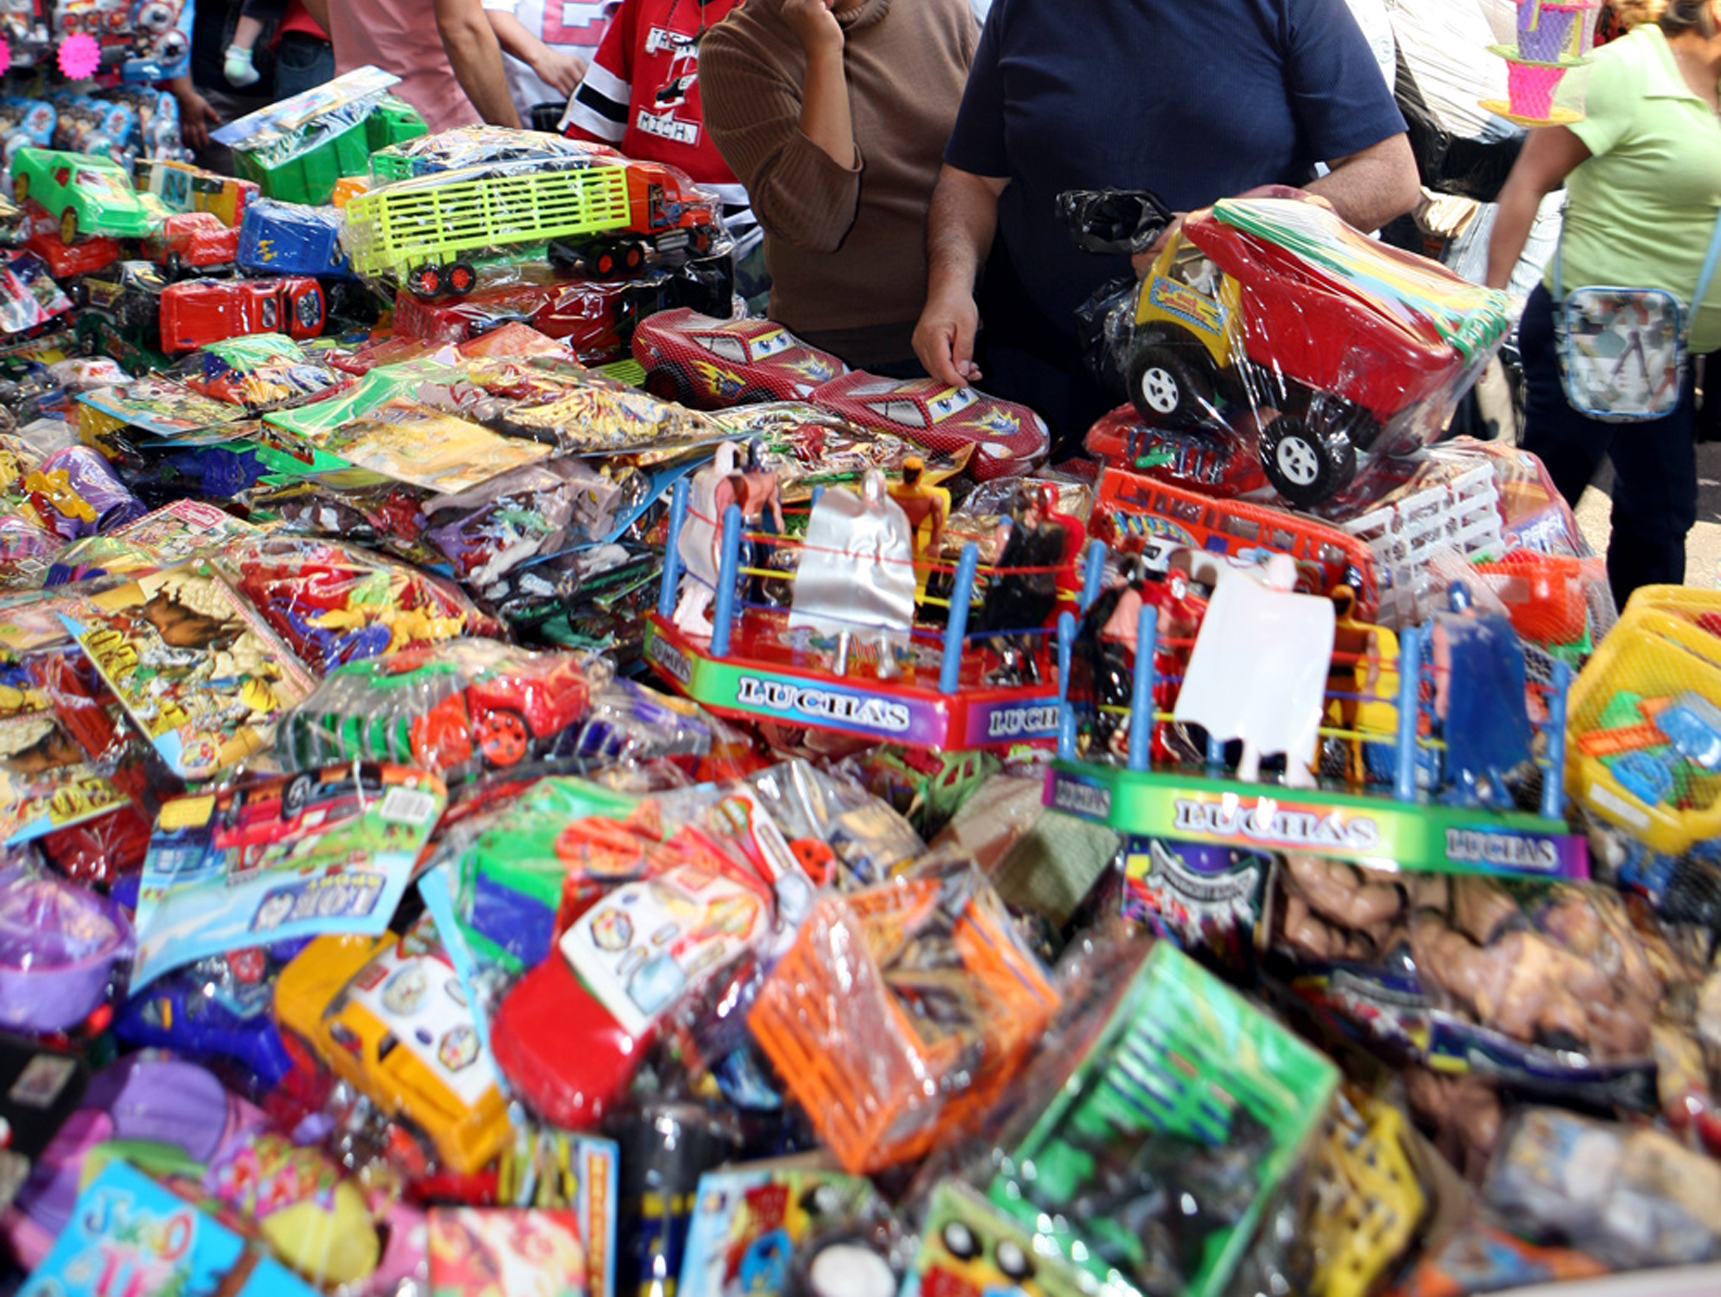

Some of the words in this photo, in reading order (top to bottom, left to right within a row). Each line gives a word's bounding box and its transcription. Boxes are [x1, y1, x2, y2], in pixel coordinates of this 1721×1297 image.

[737, 677, 910, 731] LUCHAS
[988, 706, 1060, 737] LUCH
[1175, 799, 1380, 849] LUCHAS
[1445, 828, 1560, 869] LUCHAS
